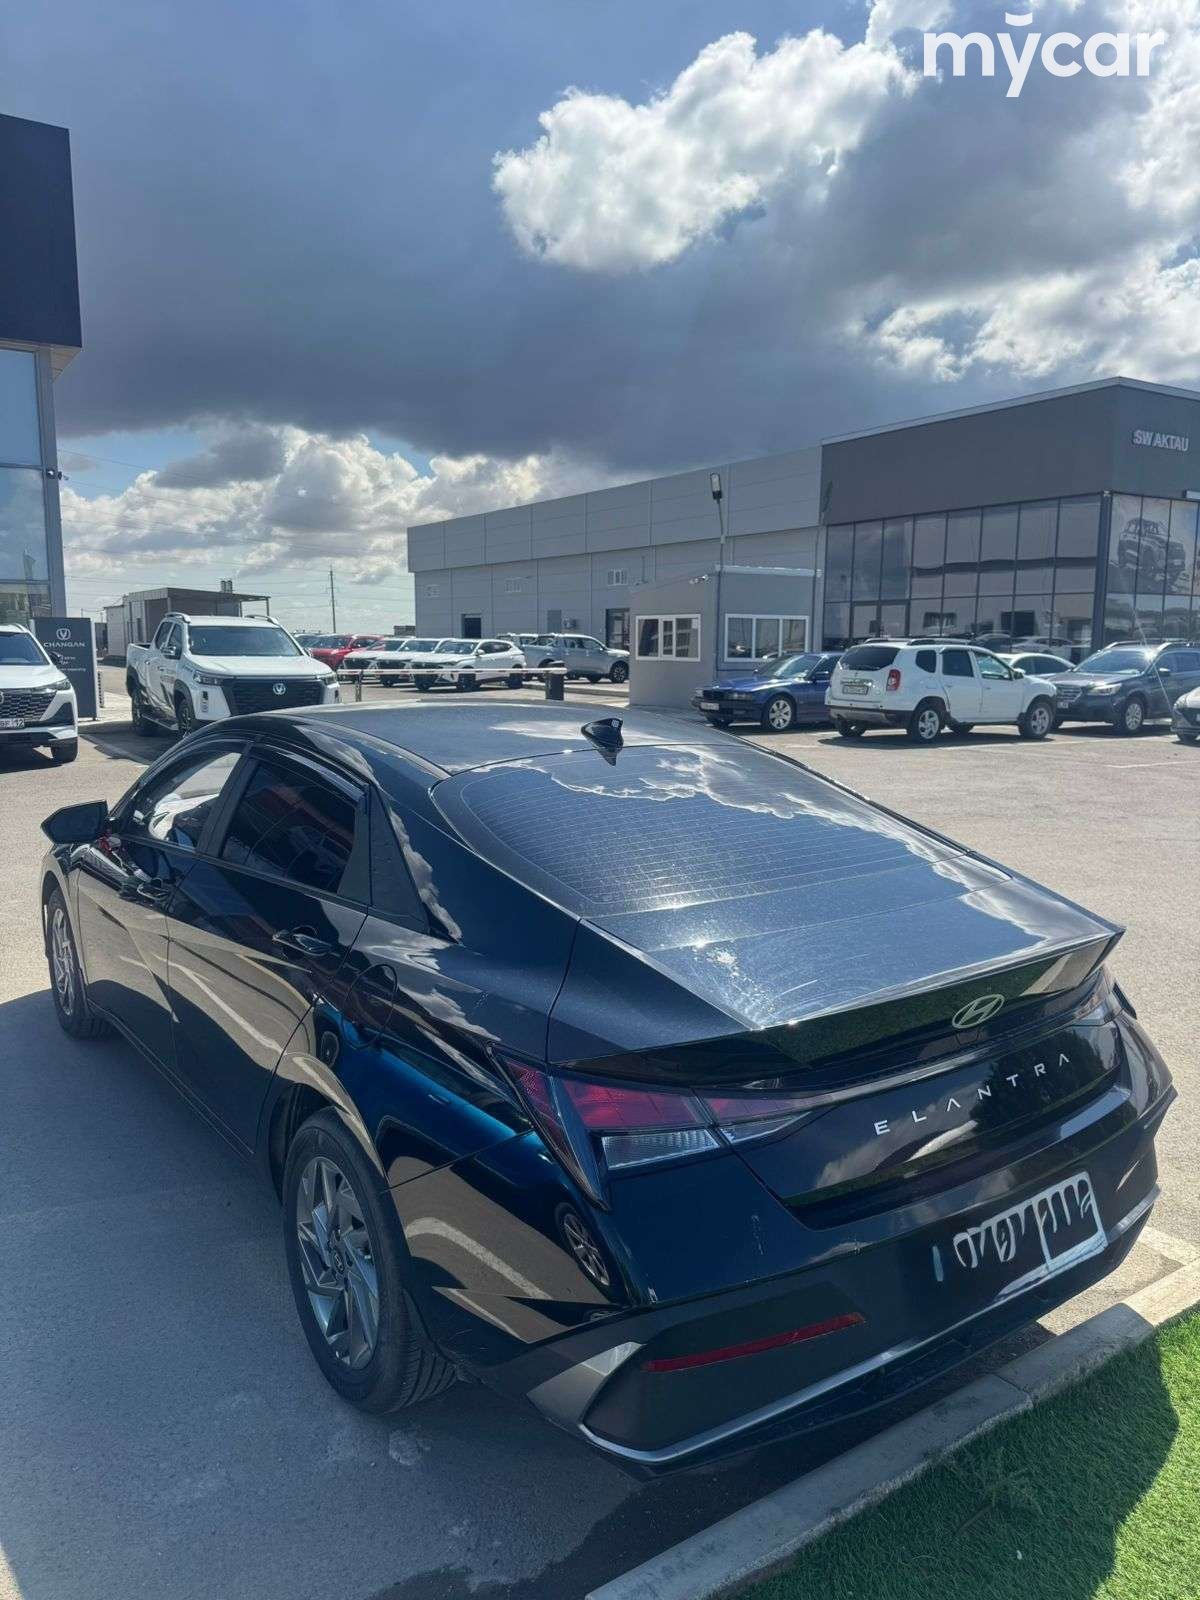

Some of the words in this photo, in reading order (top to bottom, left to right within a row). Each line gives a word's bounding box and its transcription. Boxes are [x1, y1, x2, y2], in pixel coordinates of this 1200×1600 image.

[1133, 430, 1153, 446] SW
[1153, 432, 1190, 452] AKTAU
[873, 1053, 1070, 1136] ELANTRA
